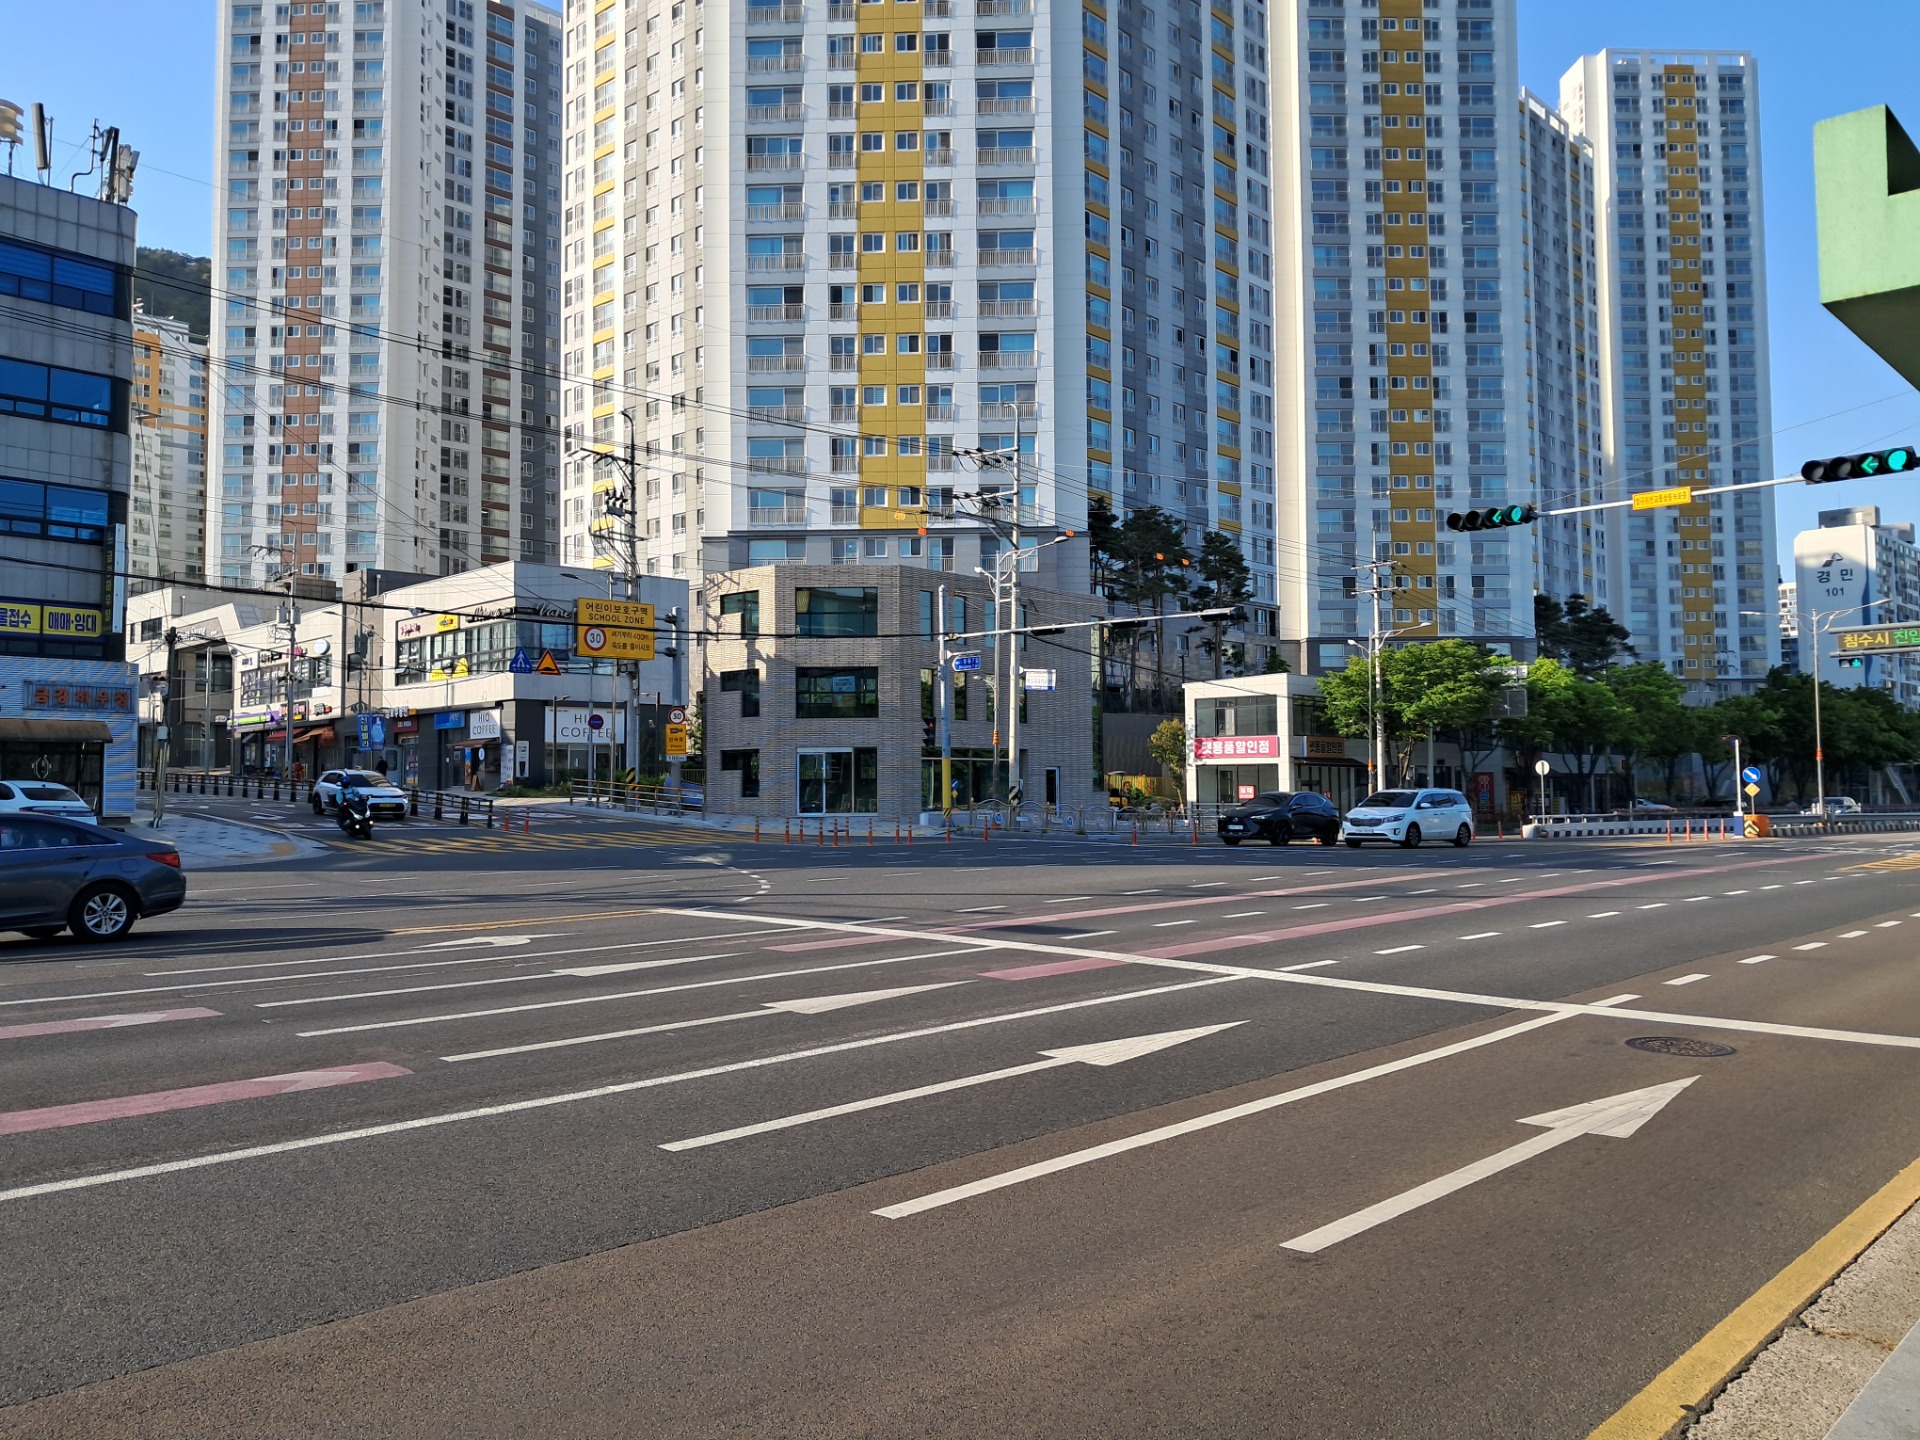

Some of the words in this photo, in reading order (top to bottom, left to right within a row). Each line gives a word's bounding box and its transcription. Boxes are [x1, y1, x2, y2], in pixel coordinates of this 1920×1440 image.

[1826, 587, 1845, 596] 101
[586, 602, 648, 616] 어린이보호구역
[48, 611, 97, 633] 매매·임대
[588, 613, 622, 623] SCHOOL
[624, 616, 645, 625] ZONE
[589, 633, 601, 643] 30
[612, 631, 632, 639] 여기부터
[1843, 631, 1890, 648] 침수시
[611, 642, 627, 650] 속도를
[472, 724, 497, 735] COFFEE
[1201, 740, 1270, 755] 펫용품할인점
